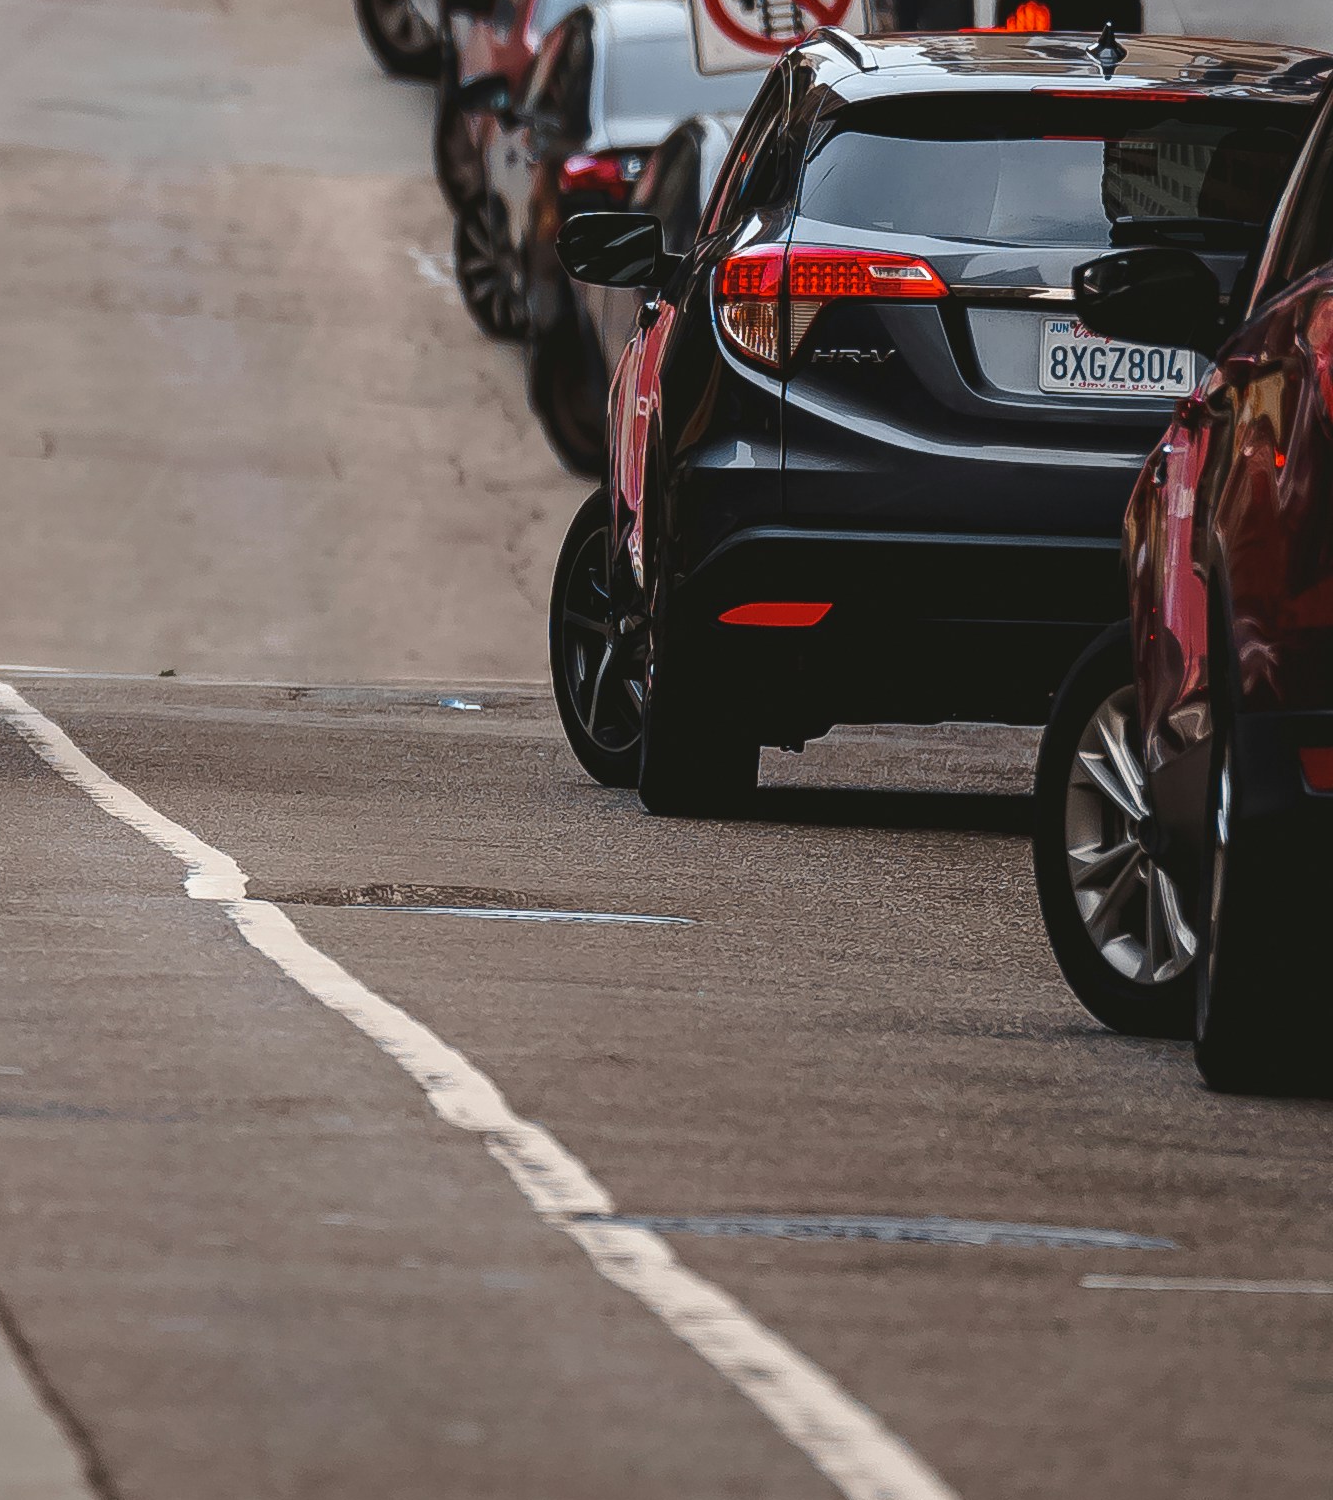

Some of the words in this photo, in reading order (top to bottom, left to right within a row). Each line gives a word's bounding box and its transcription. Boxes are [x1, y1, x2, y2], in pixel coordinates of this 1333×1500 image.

[1049, 322, 1070, 333] JUN
[811, 349, 896, 363] HR-V
[1051, 345, 1184, 384] 8XGZ804
